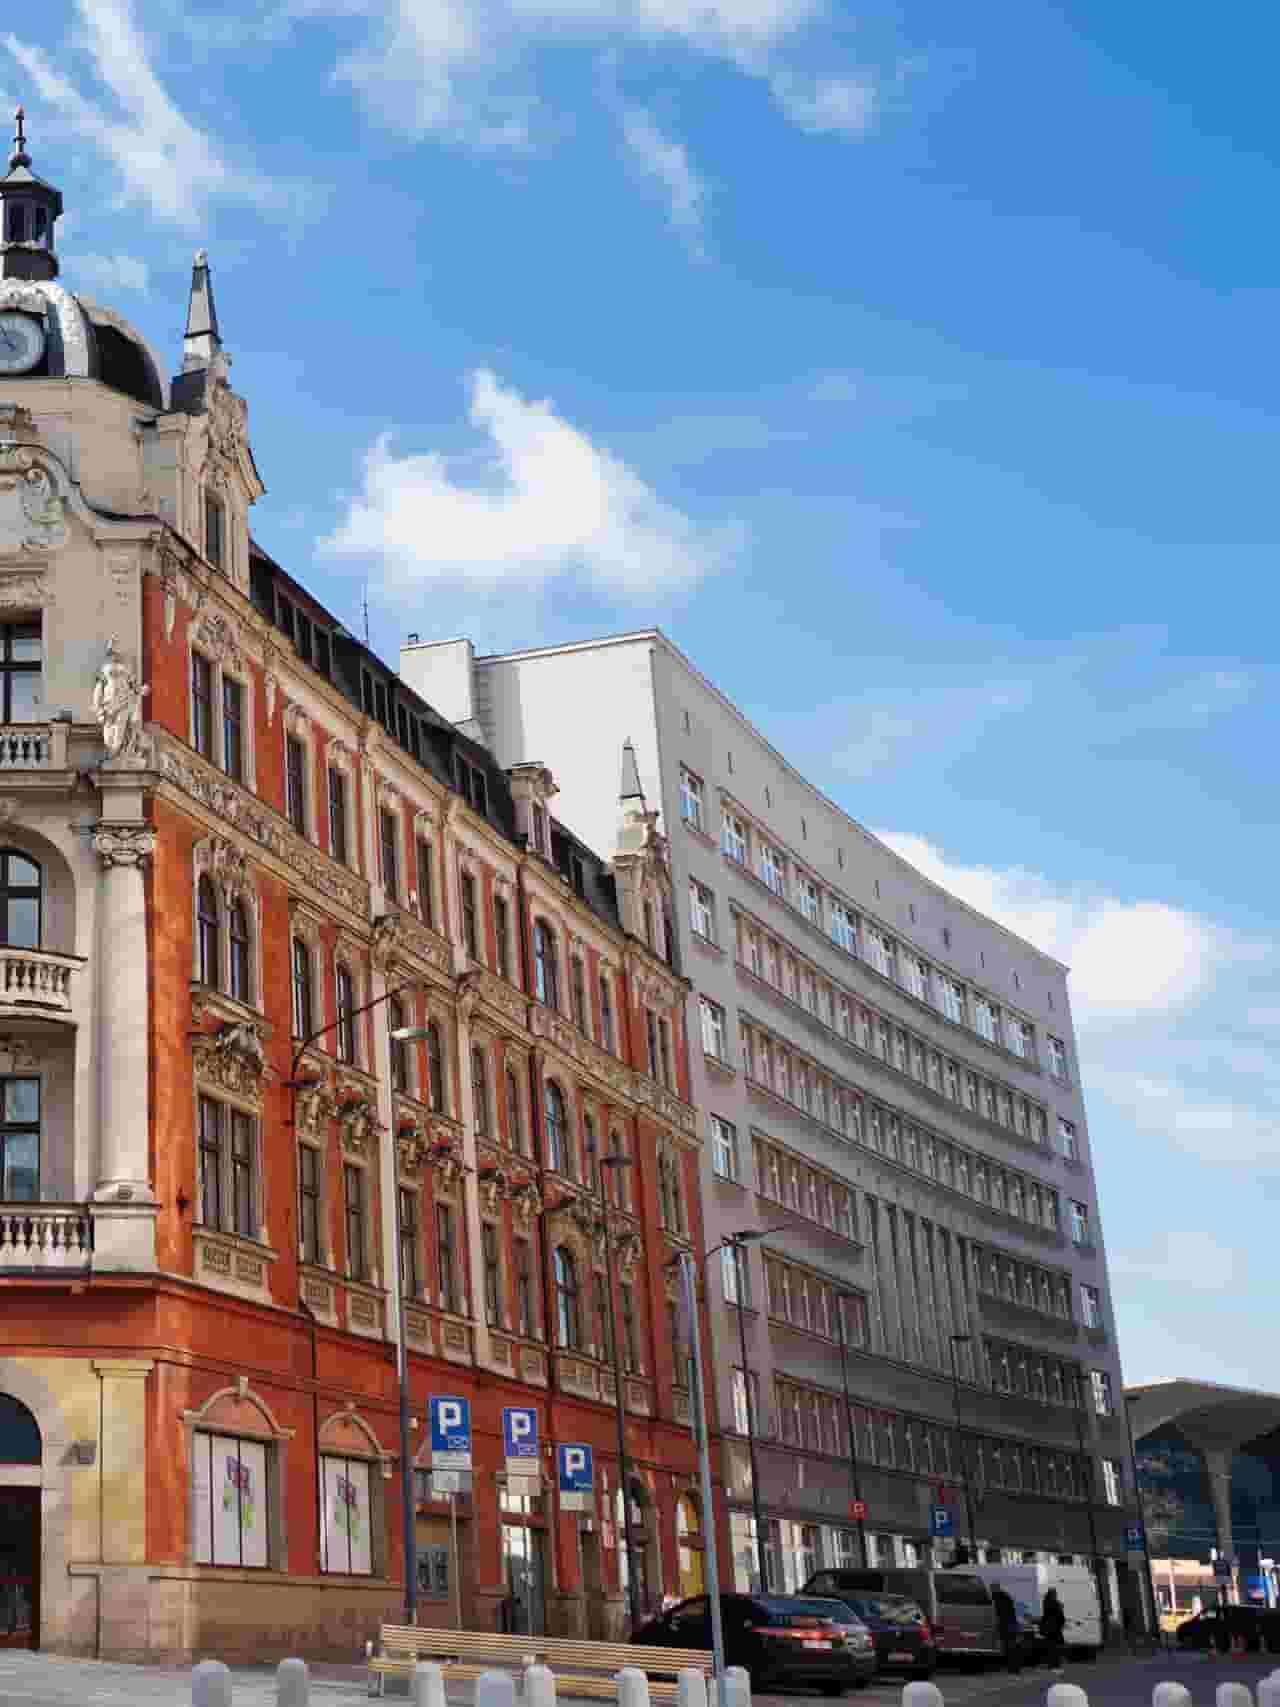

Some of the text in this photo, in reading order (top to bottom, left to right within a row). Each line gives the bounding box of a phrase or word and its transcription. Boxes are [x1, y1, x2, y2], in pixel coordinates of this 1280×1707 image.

[438, 1401, 461, 1435] P
[511, 1412, 531, 1443] P
[566, 1447, 585, 1478] P
[935, 1511, 948, 1528] P
